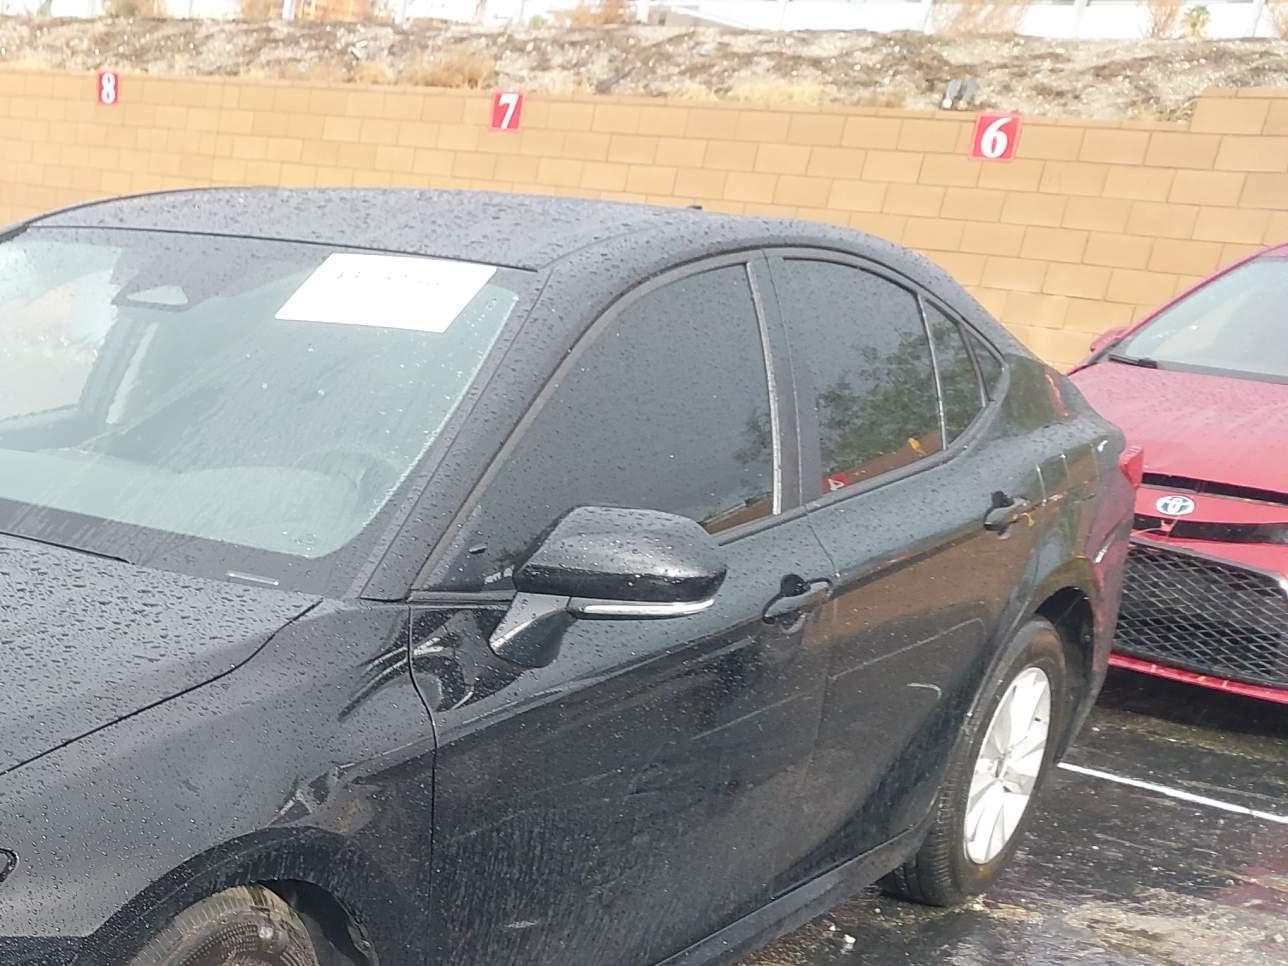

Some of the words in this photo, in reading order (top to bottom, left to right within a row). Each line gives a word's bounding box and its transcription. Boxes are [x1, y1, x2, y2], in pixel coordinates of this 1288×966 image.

[101, 72, 116, 104] 8
[498, 93, 520, 129] 7
[981, 117, 1013, 159] 6
